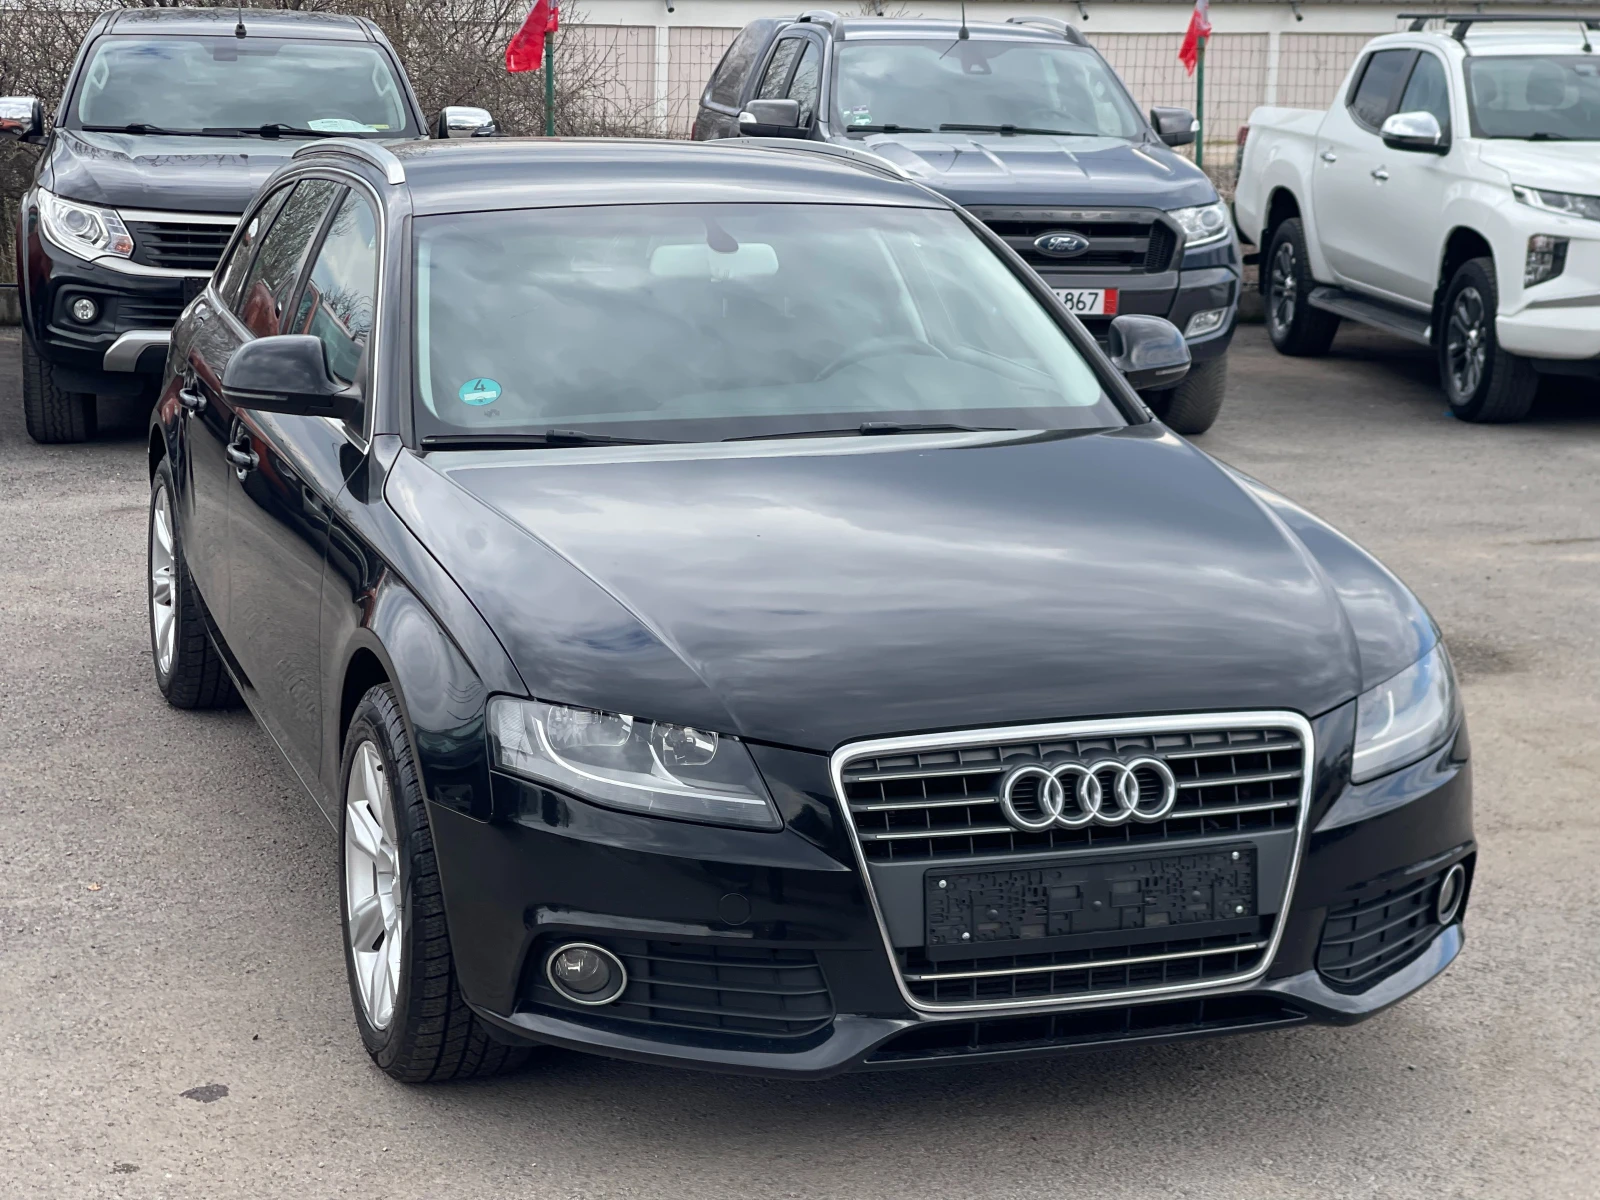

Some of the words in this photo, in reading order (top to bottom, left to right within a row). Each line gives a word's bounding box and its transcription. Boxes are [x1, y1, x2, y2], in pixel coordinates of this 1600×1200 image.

[980, 210, 1141, 220] RANGER
[1047, 236, 1078, 250] Ford
[1056, 292, 1099, 311] 867
[473, 379, 486, 391] 4
